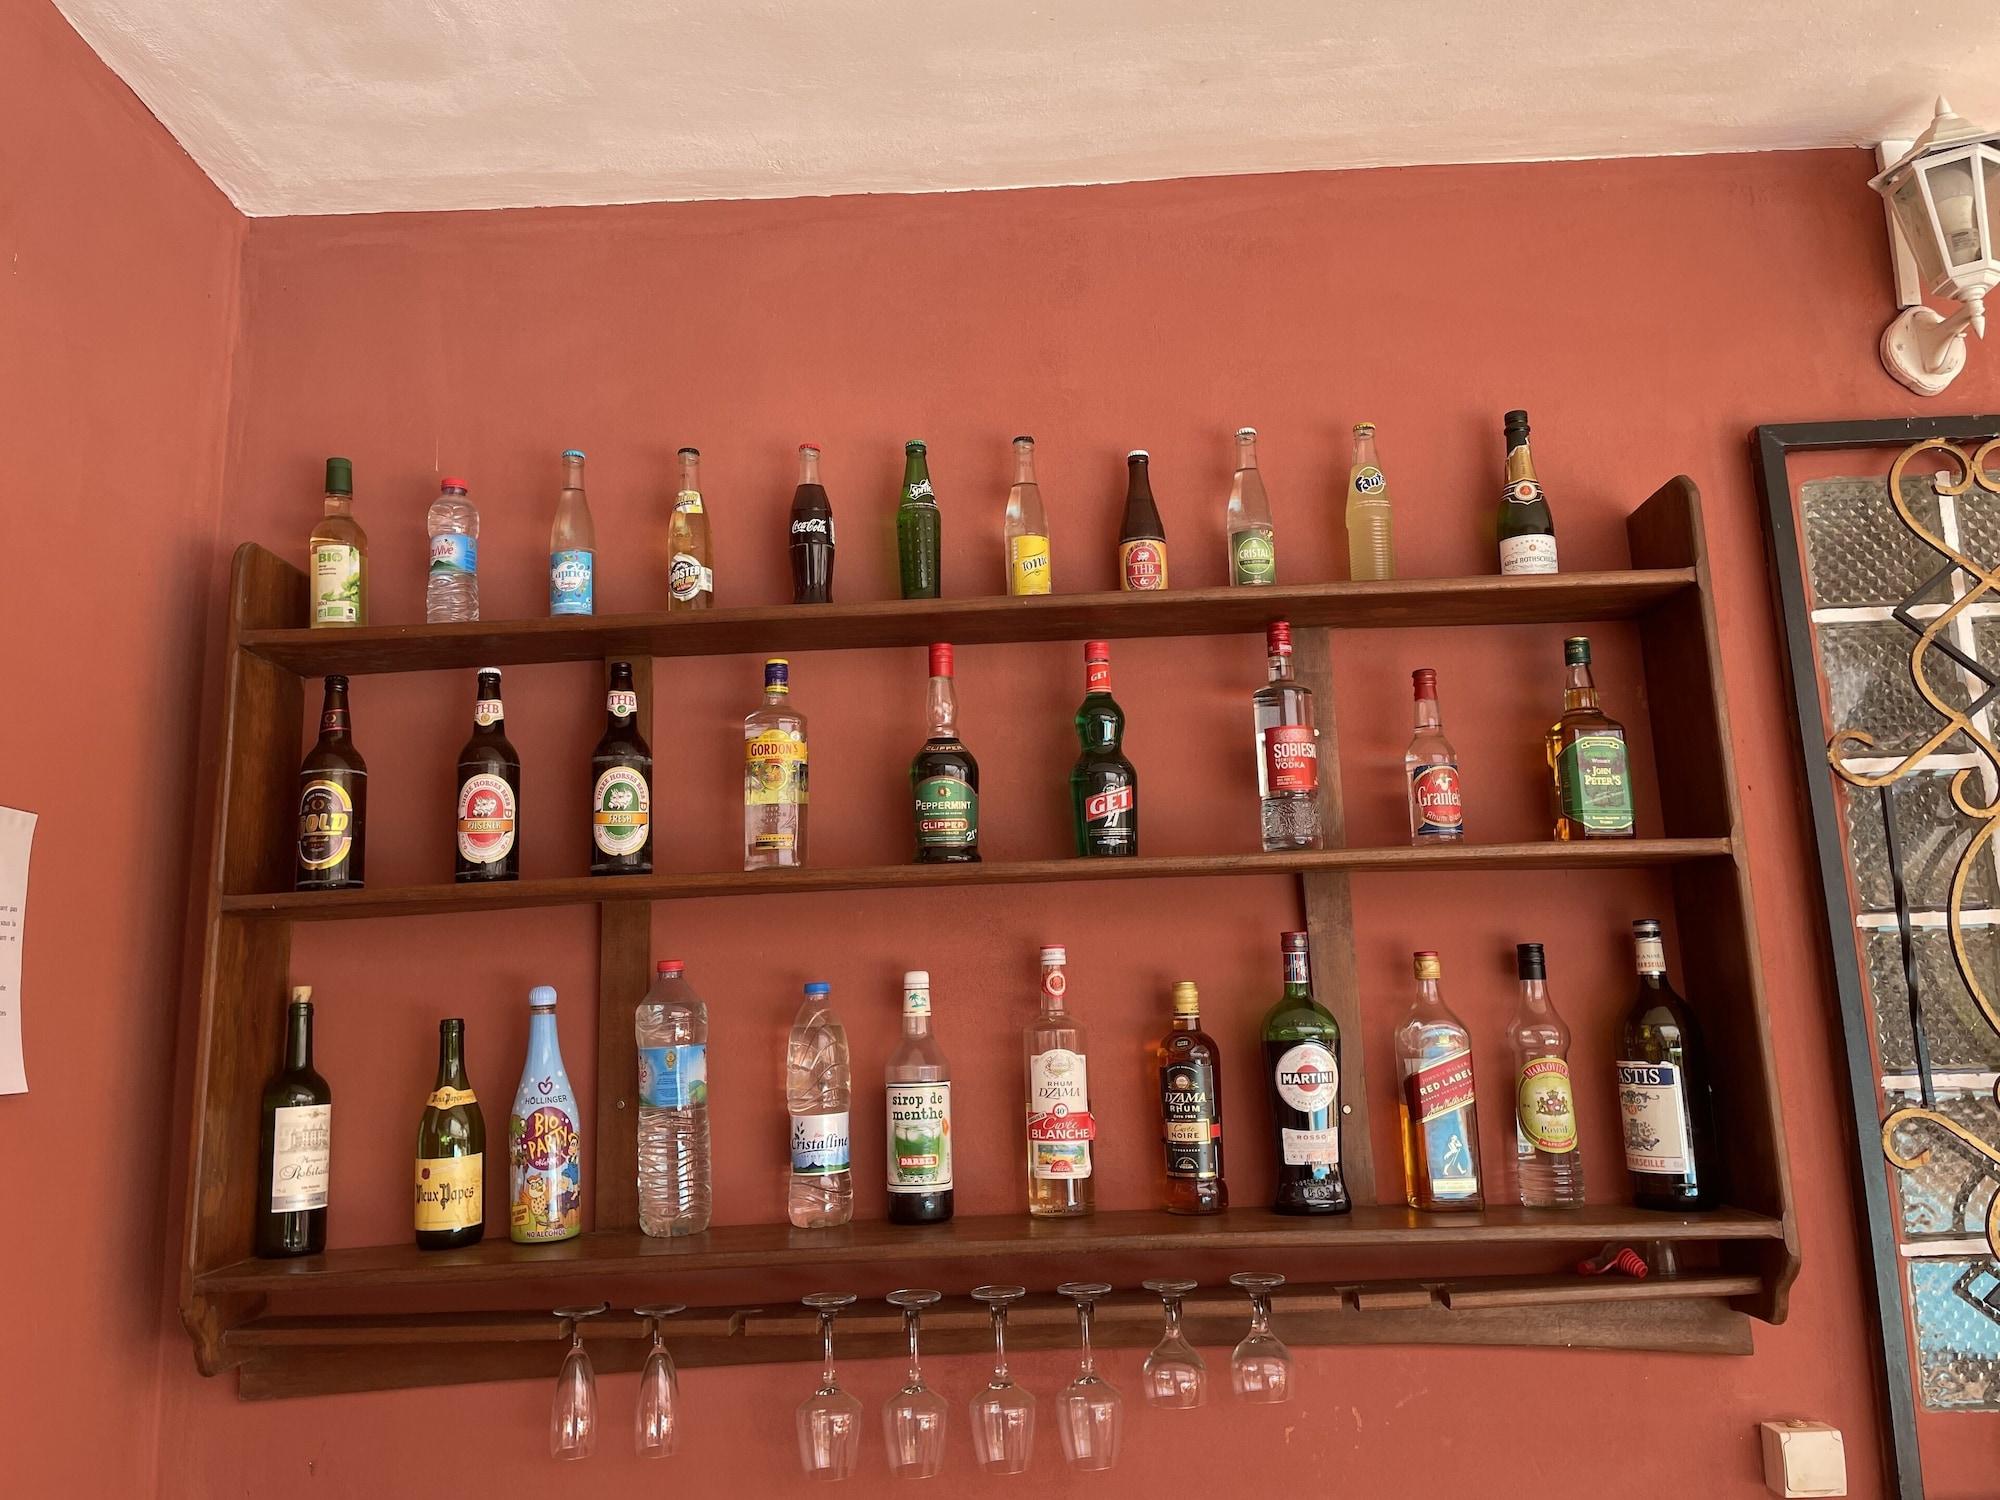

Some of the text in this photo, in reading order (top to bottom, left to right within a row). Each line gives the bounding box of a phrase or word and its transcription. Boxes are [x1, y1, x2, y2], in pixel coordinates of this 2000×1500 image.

[318, 551, 343, 563] BIO
[1239, 549, 1269, 559] CRISTAL
[1132, 563, 1155, 575] THB
[1090, 670, 1109, 682] GET
[609, 694, 636, 706] THB
[476, 703, 500, 715] THB
[750, 742, 799, 757] GORDON'S
[925, 744, 964, 752] CLIPPER
[1275, 761, 1306, 770] VODKA
[1591, 766, 1612, 776] JOHN
[1584, 774, 1622, 786] PETER'S
[596, 772, 647, 801] THREE HORSES BEER
[474, 779, 503, 790] HORSES
[500, 788, 511, 807] BEER
[915, 799, 972, 811] PEPPERMINT
[1089, 789, 1131, 816] GET
[300, 812, 349, 833] OLD
[608, 814, 632, 824] FRESH
[922, 821, 965, 831] CLIPPER
[1281, 1071, 1334, 1085] MARTINI
[1617, 1066, 1661, 1085] ASTIS
[1419, 1068, 1473, 1096] RED LABEL
[893, 1092, 943, 1108] sirop de
[893, 1107, 944, 1121] menthe
[1169, 1104, 1201, 1113] RHUM
[533, 1113, 560, 1138] BIO
[1031, 1128, 1090, 1140] BLANCHE
[1171, 1132, 1200, 1140] NOIRE
[1296, 1133, 1328, 1141] ROSSO
[527, 1126, 569, 1161] PARTY
[791, 1133, 848, 1151] Cristalline
[439, 1182, 475, 1210] Papes
[526, 1229, 567, 1239] NO ALCOHOL
